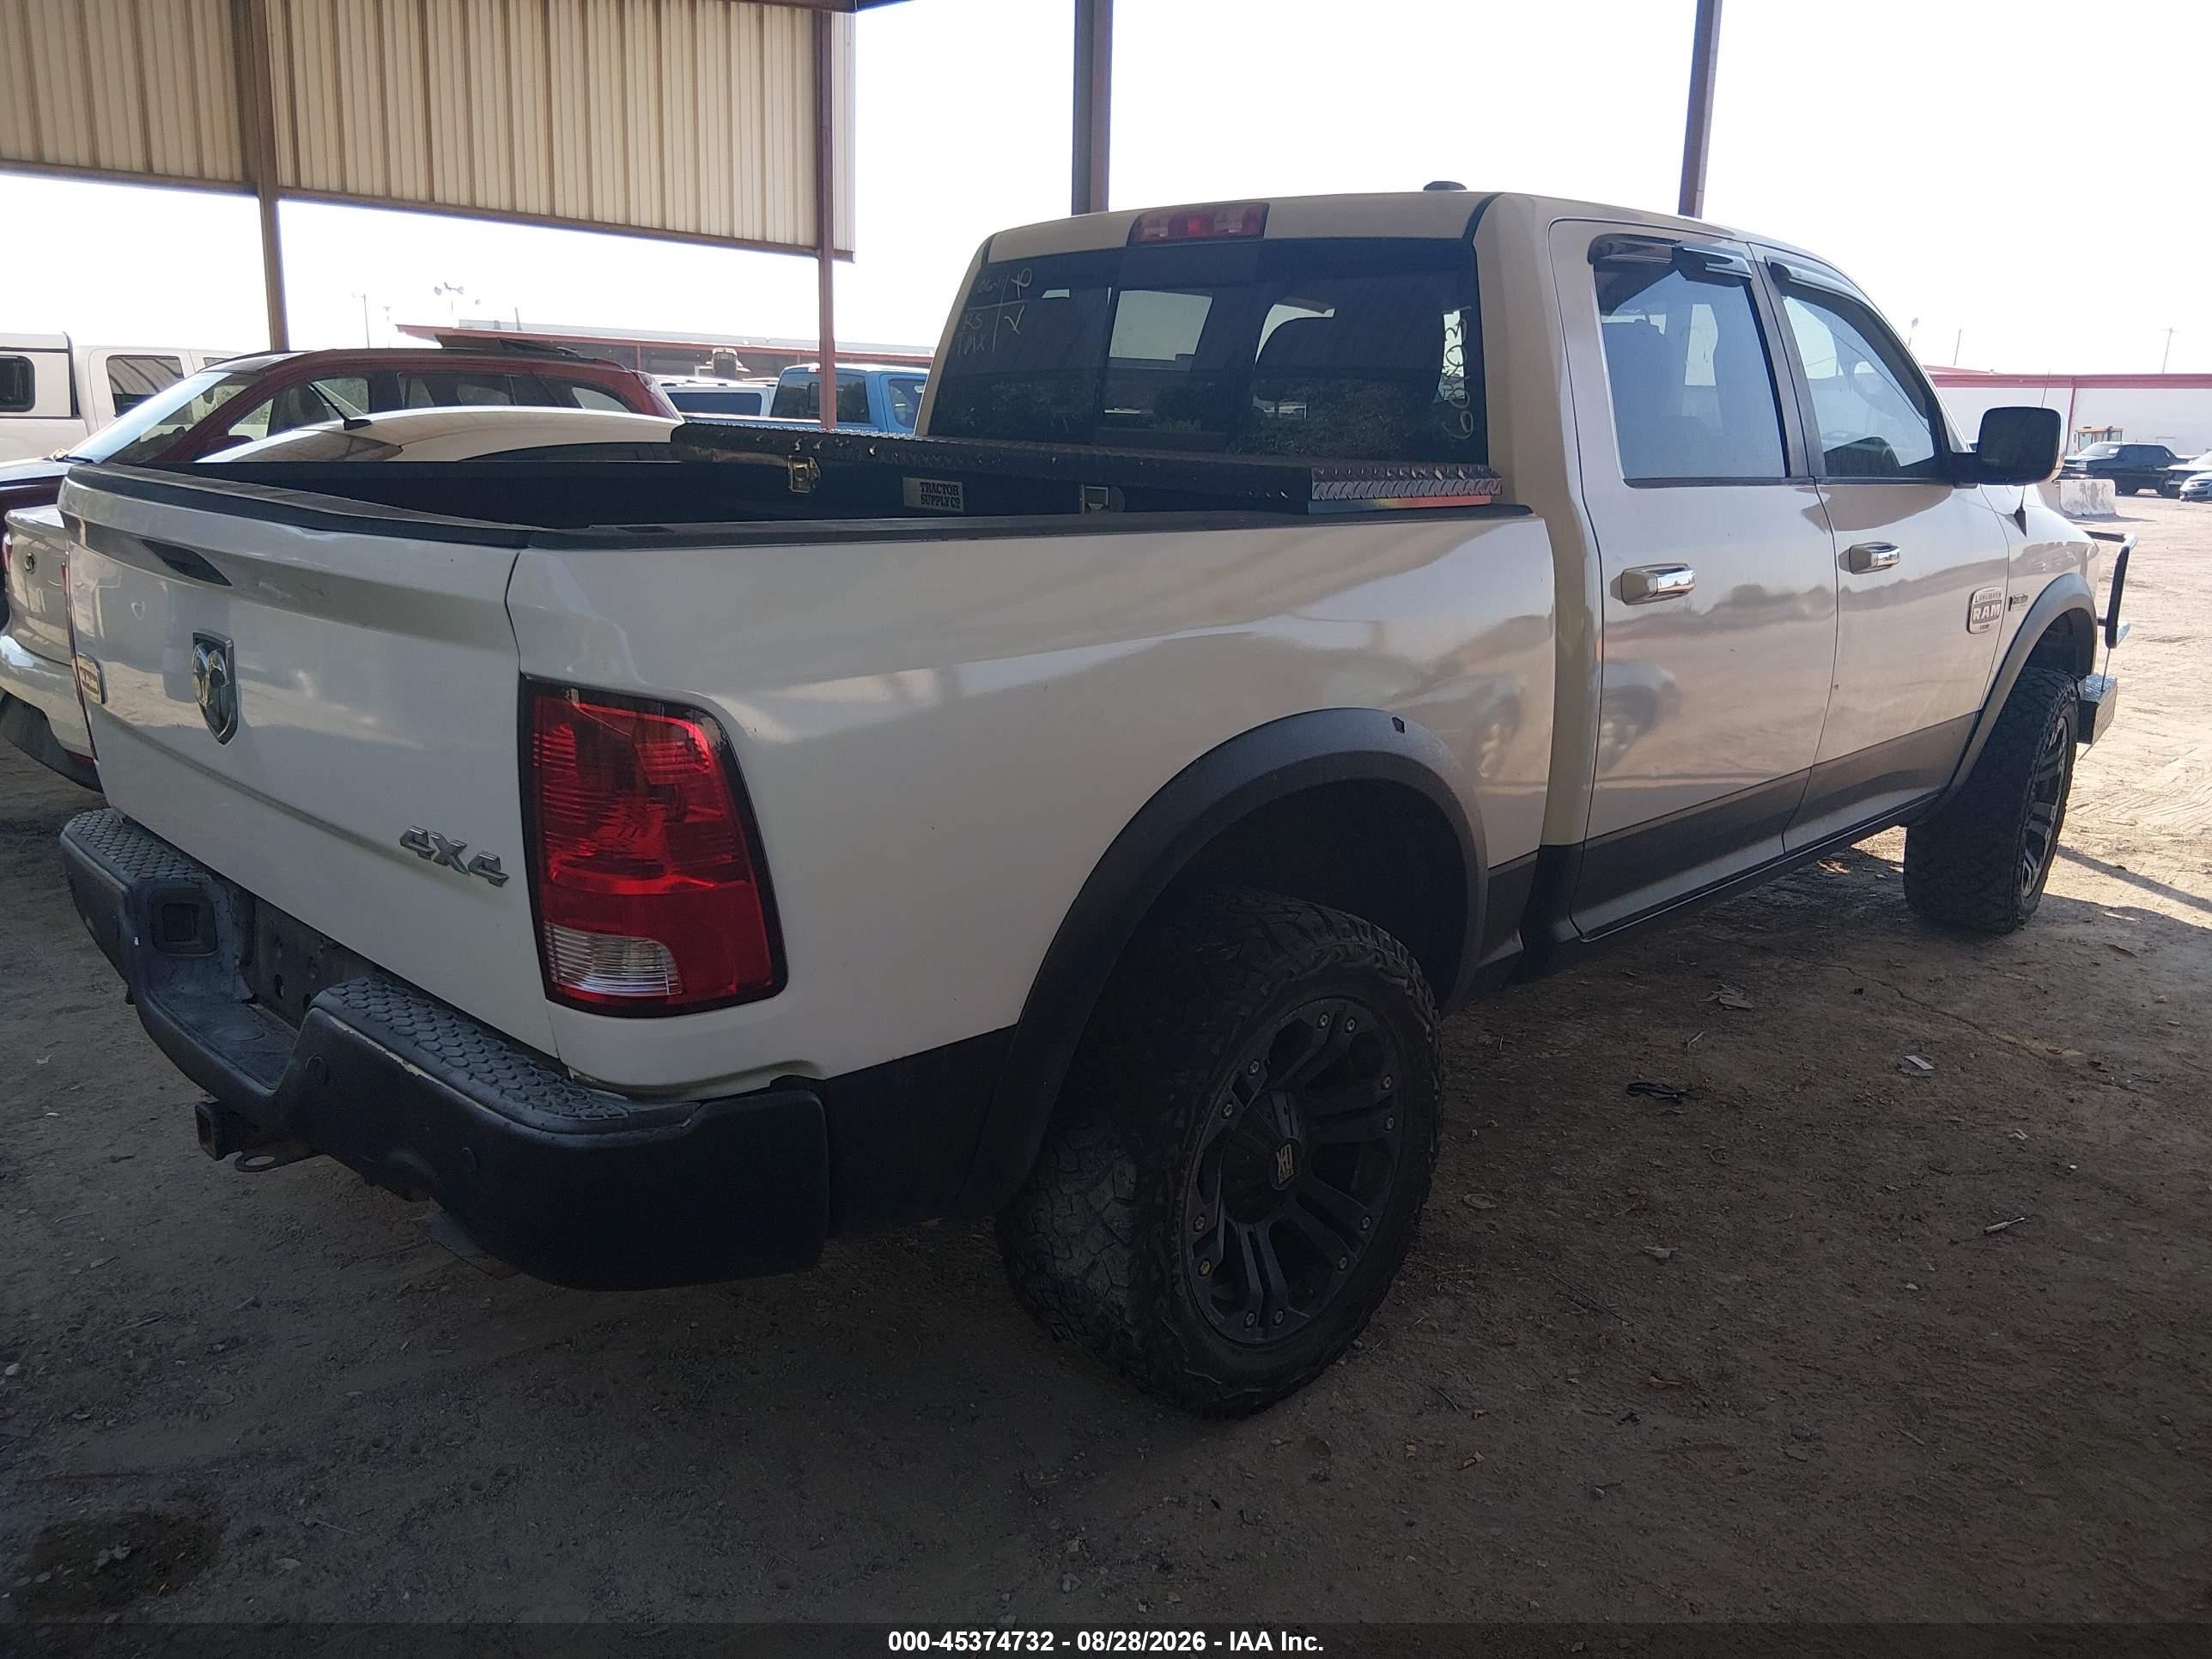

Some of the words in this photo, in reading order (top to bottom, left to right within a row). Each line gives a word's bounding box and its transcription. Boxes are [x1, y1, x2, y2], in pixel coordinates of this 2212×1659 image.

[920, 482, 959, 495] TRACTOR
[921, 494, 950, 507] SUPPLY
[1972, 604, 2001, 620] RAM
